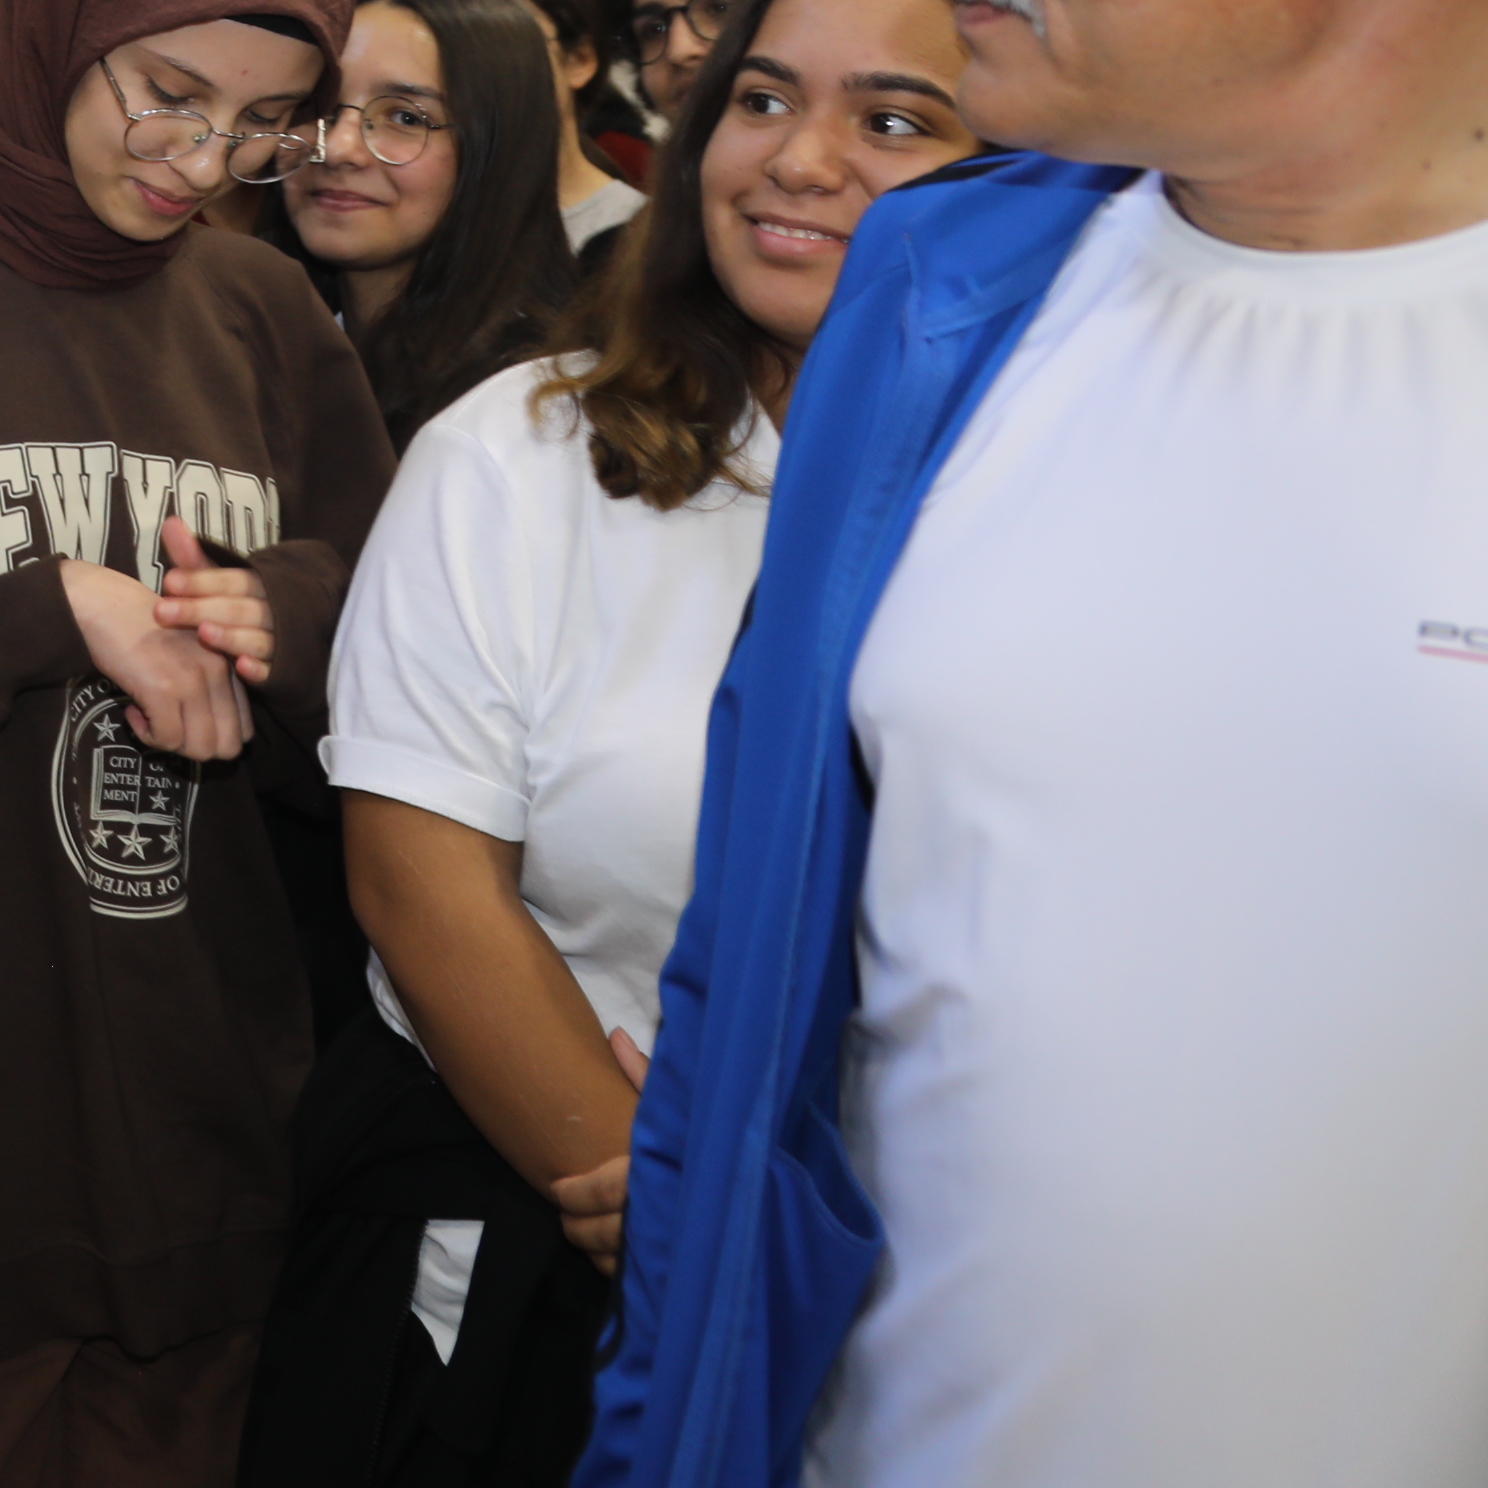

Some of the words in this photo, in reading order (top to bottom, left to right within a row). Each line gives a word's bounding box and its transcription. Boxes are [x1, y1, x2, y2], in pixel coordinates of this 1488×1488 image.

[109, 755, 137, 769] CITY
[104, 773, 141, 786] ENTER
[103, 790, 138, 803] MENT
[157, 874, 180, 895] OF
